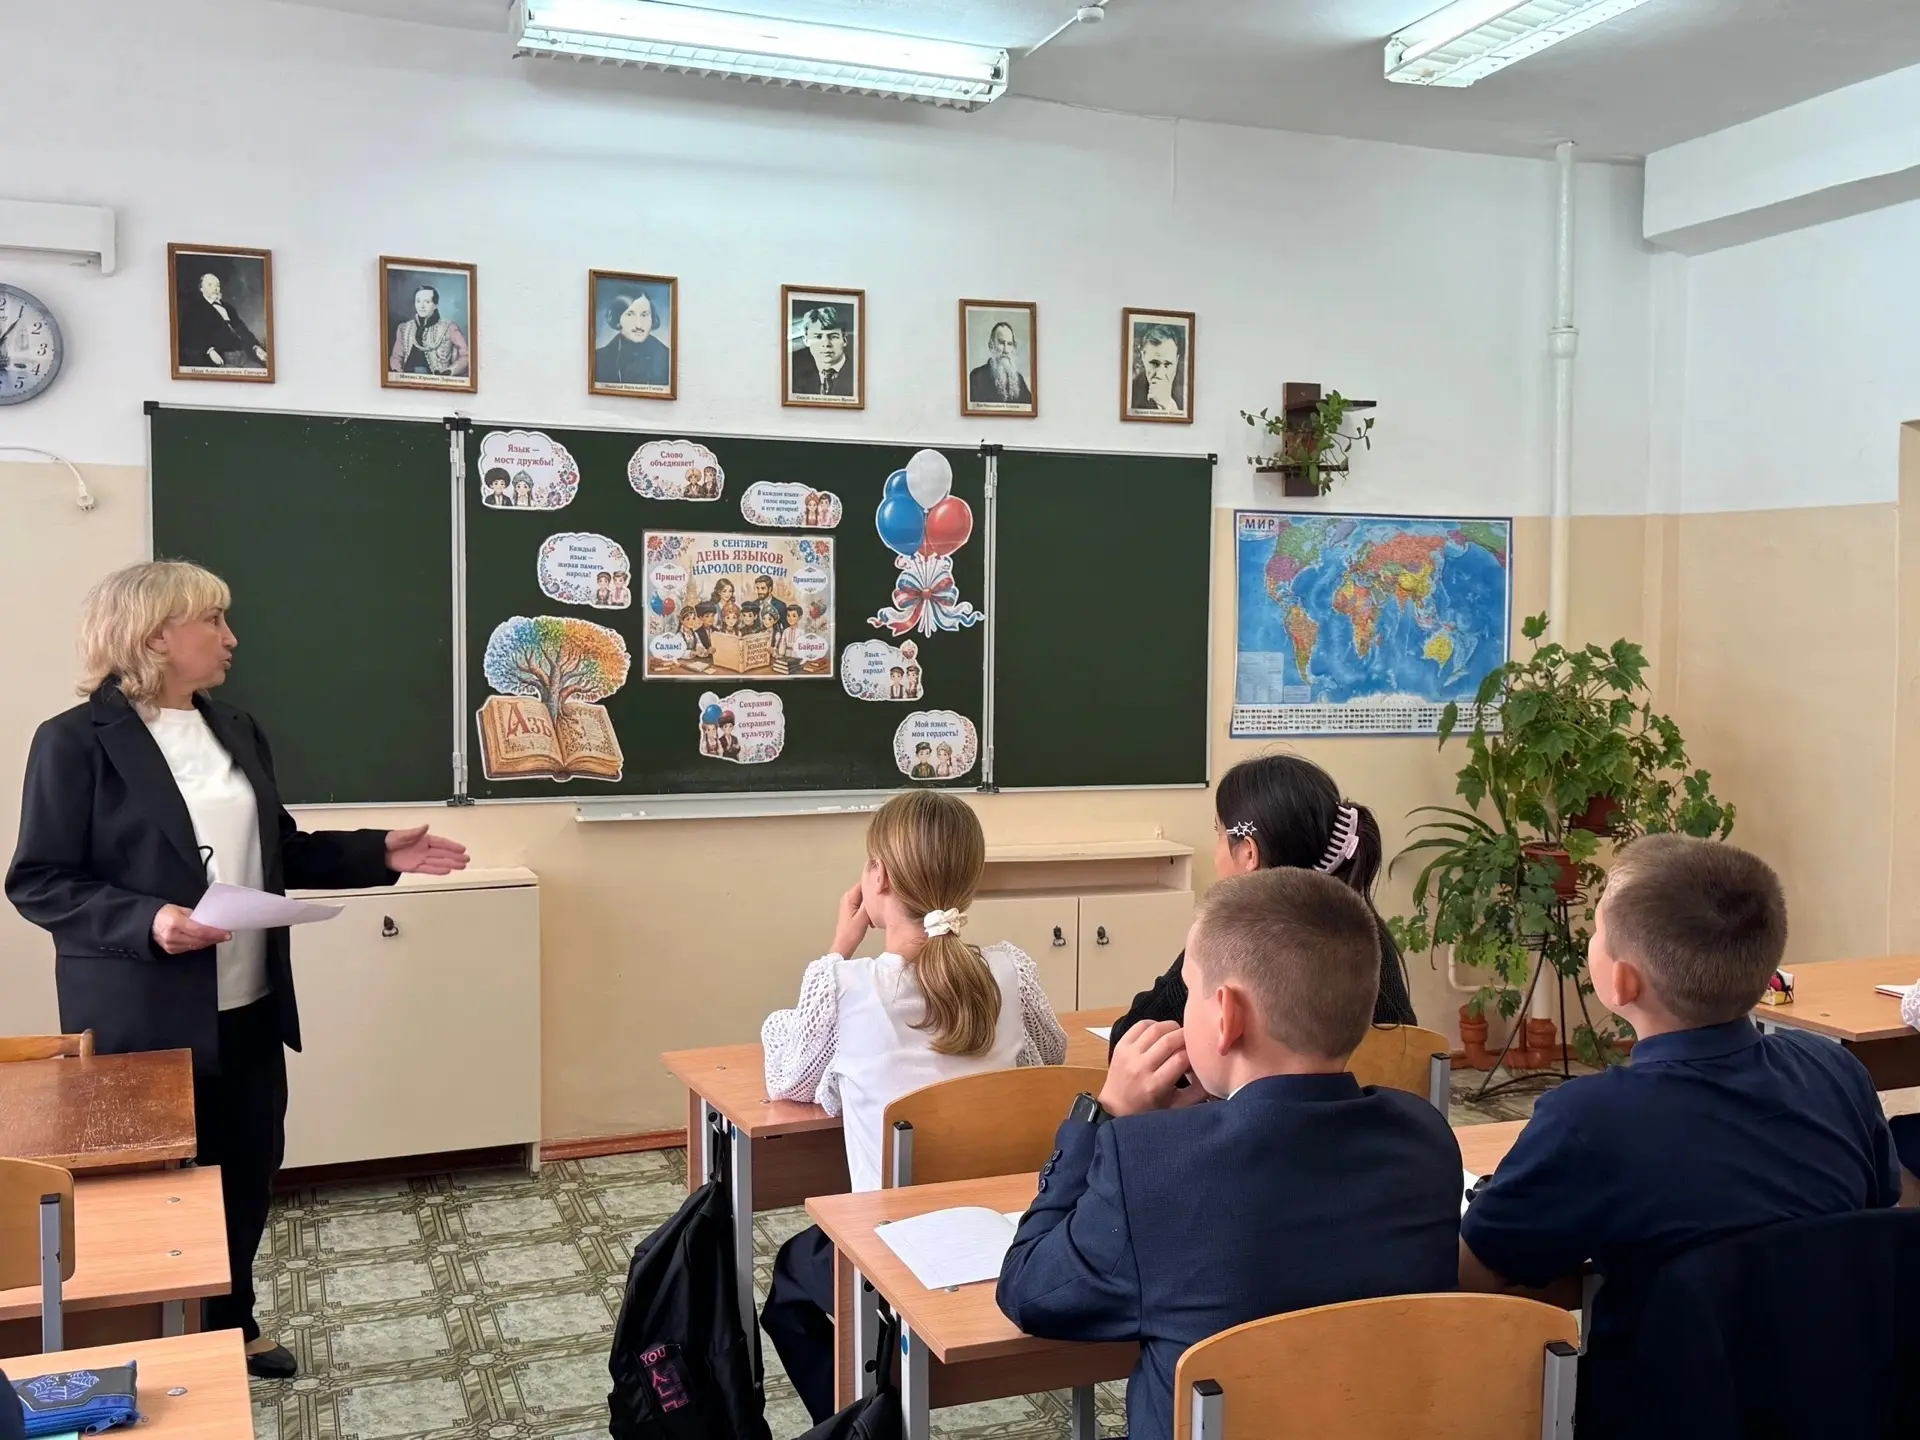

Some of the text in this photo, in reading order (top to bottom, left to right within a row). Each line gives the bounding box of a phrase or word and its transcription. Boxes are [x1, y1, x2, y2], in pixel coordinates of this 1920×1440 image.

[31, 322, 42, 335] 2
[37, 343, 47, 356] 3
[31, 363, 41, 376] 4
[14, 376, 24, 389] 5
[508, 444, 531, 453] Язык
[660, 451, 684, 459] Слово
[517, 457, 554, 467] дружбы!
[649, 460, 695, 468] объединяет!
[1245, 518, 1275, 529] МИР
[713, 539, 768, 549] 8 СЕНТЯБРЯ
[696, 549, 784, 565] ДЕНЬ ЯЗЫКОВ
[692, 563, 788, 578] НАРОДОВ РОССИИ
[655, 572, 686, 582] Привет!
[655, 642, 682, 650] Салам!
[863, 667, 886, 675] народа!
[738, 720, 776, 729] сохраняем
[914, 720, 929, 728] Мой
[741, 730, 774, 739] культуру
[926, 730, 959, 738] гордость!
[640, 1346, 666, 1365] YOU
